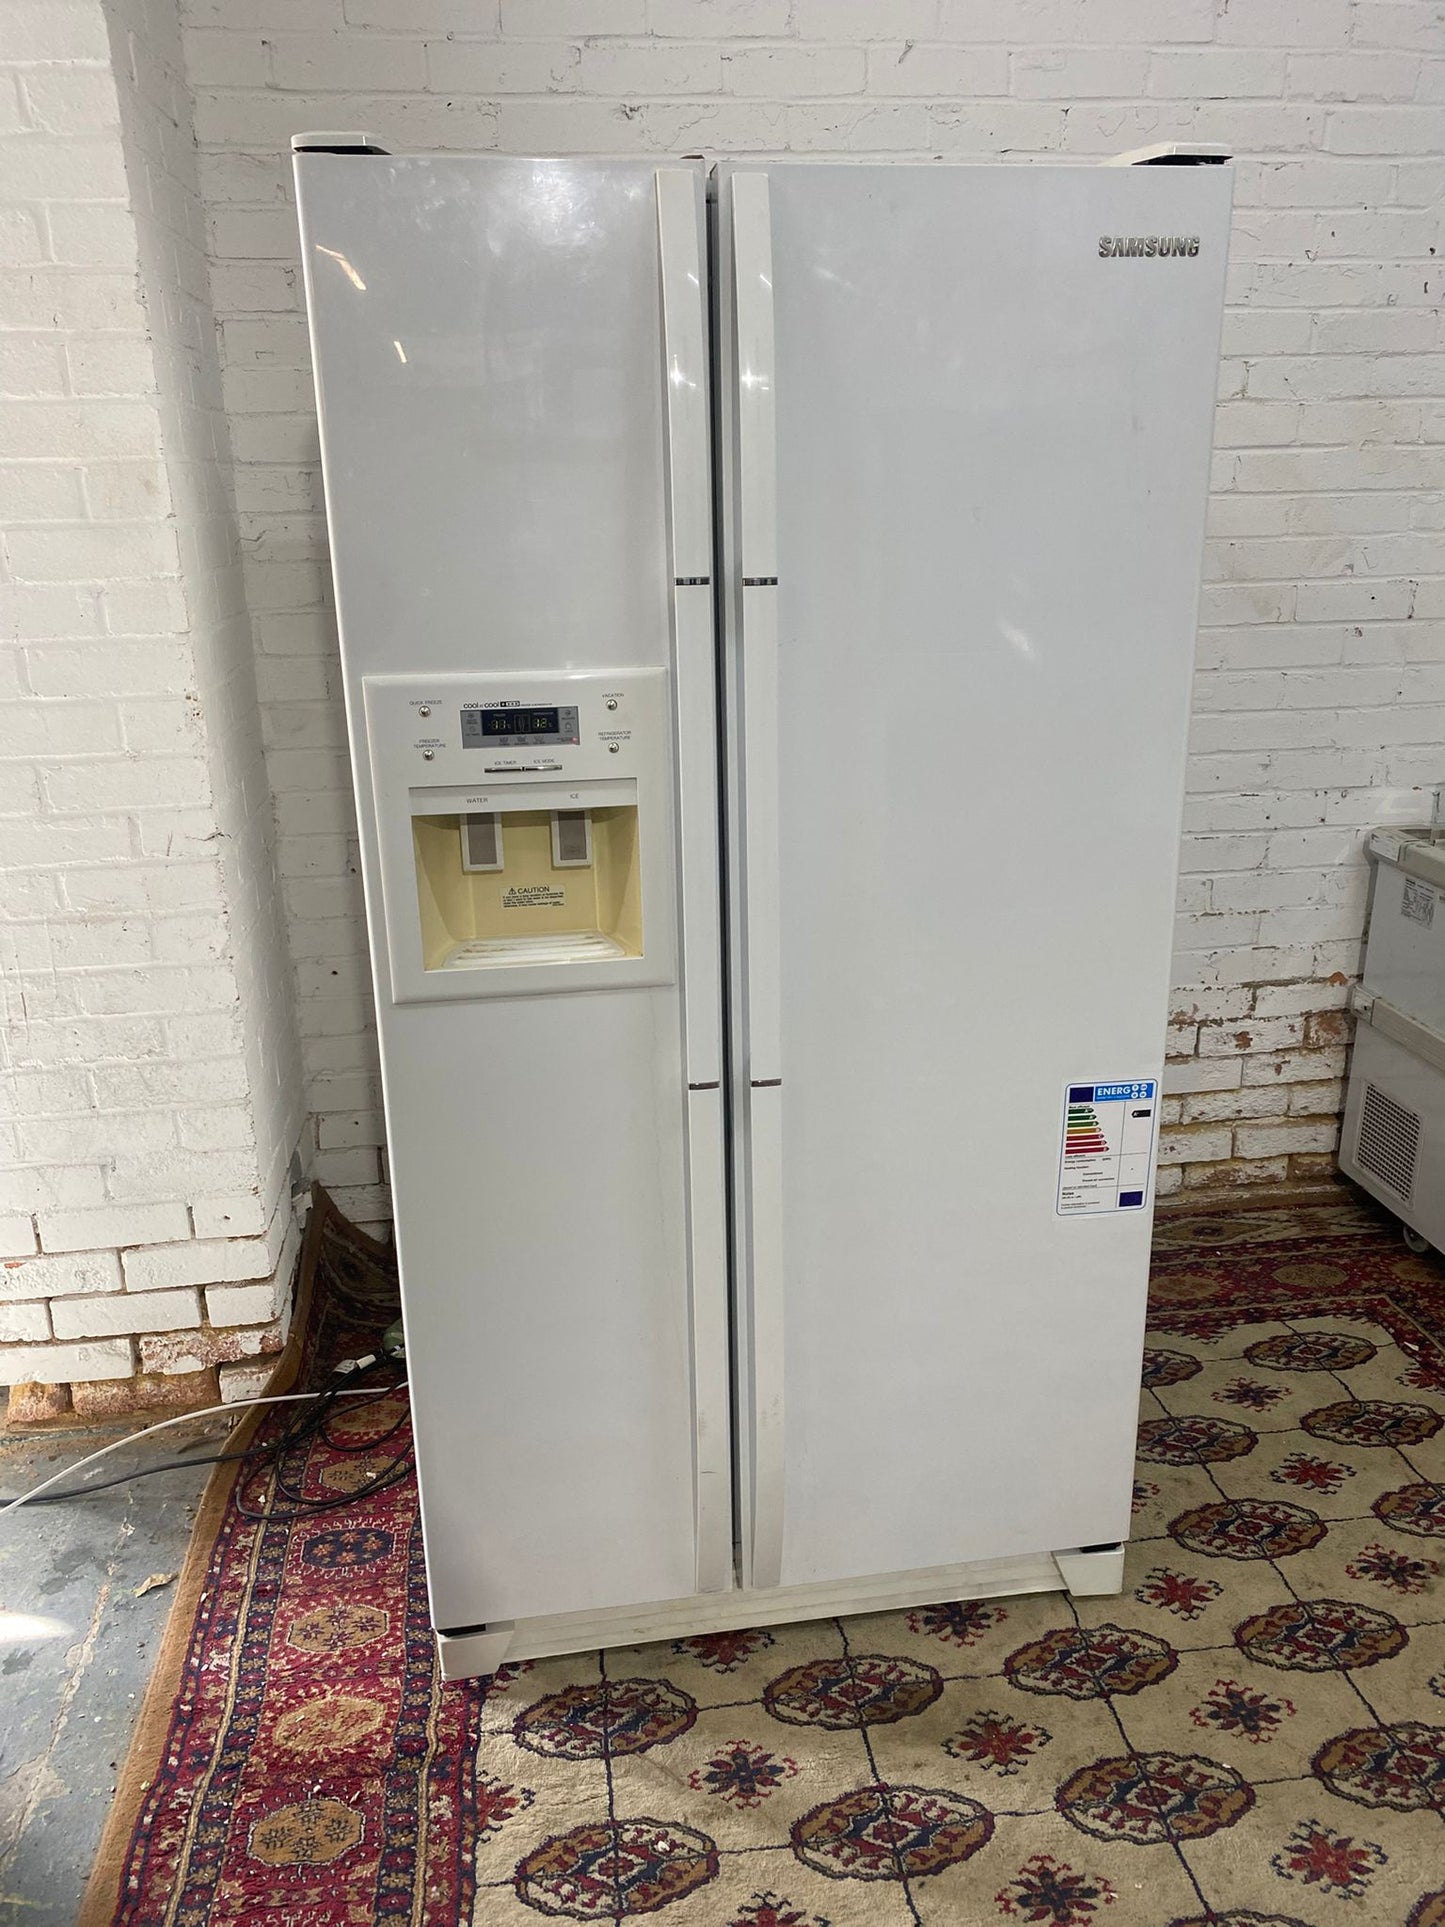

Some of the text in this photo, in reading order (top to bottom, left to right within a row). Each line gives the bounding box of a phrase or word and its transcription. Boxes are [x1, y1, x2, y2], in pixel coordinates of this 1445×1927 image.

[1098, 236, 1200, 258] SAMSUNG
[517, 886, 550, 894] CAUTION
[1097, 1086, 1131, 1096] ENERG
